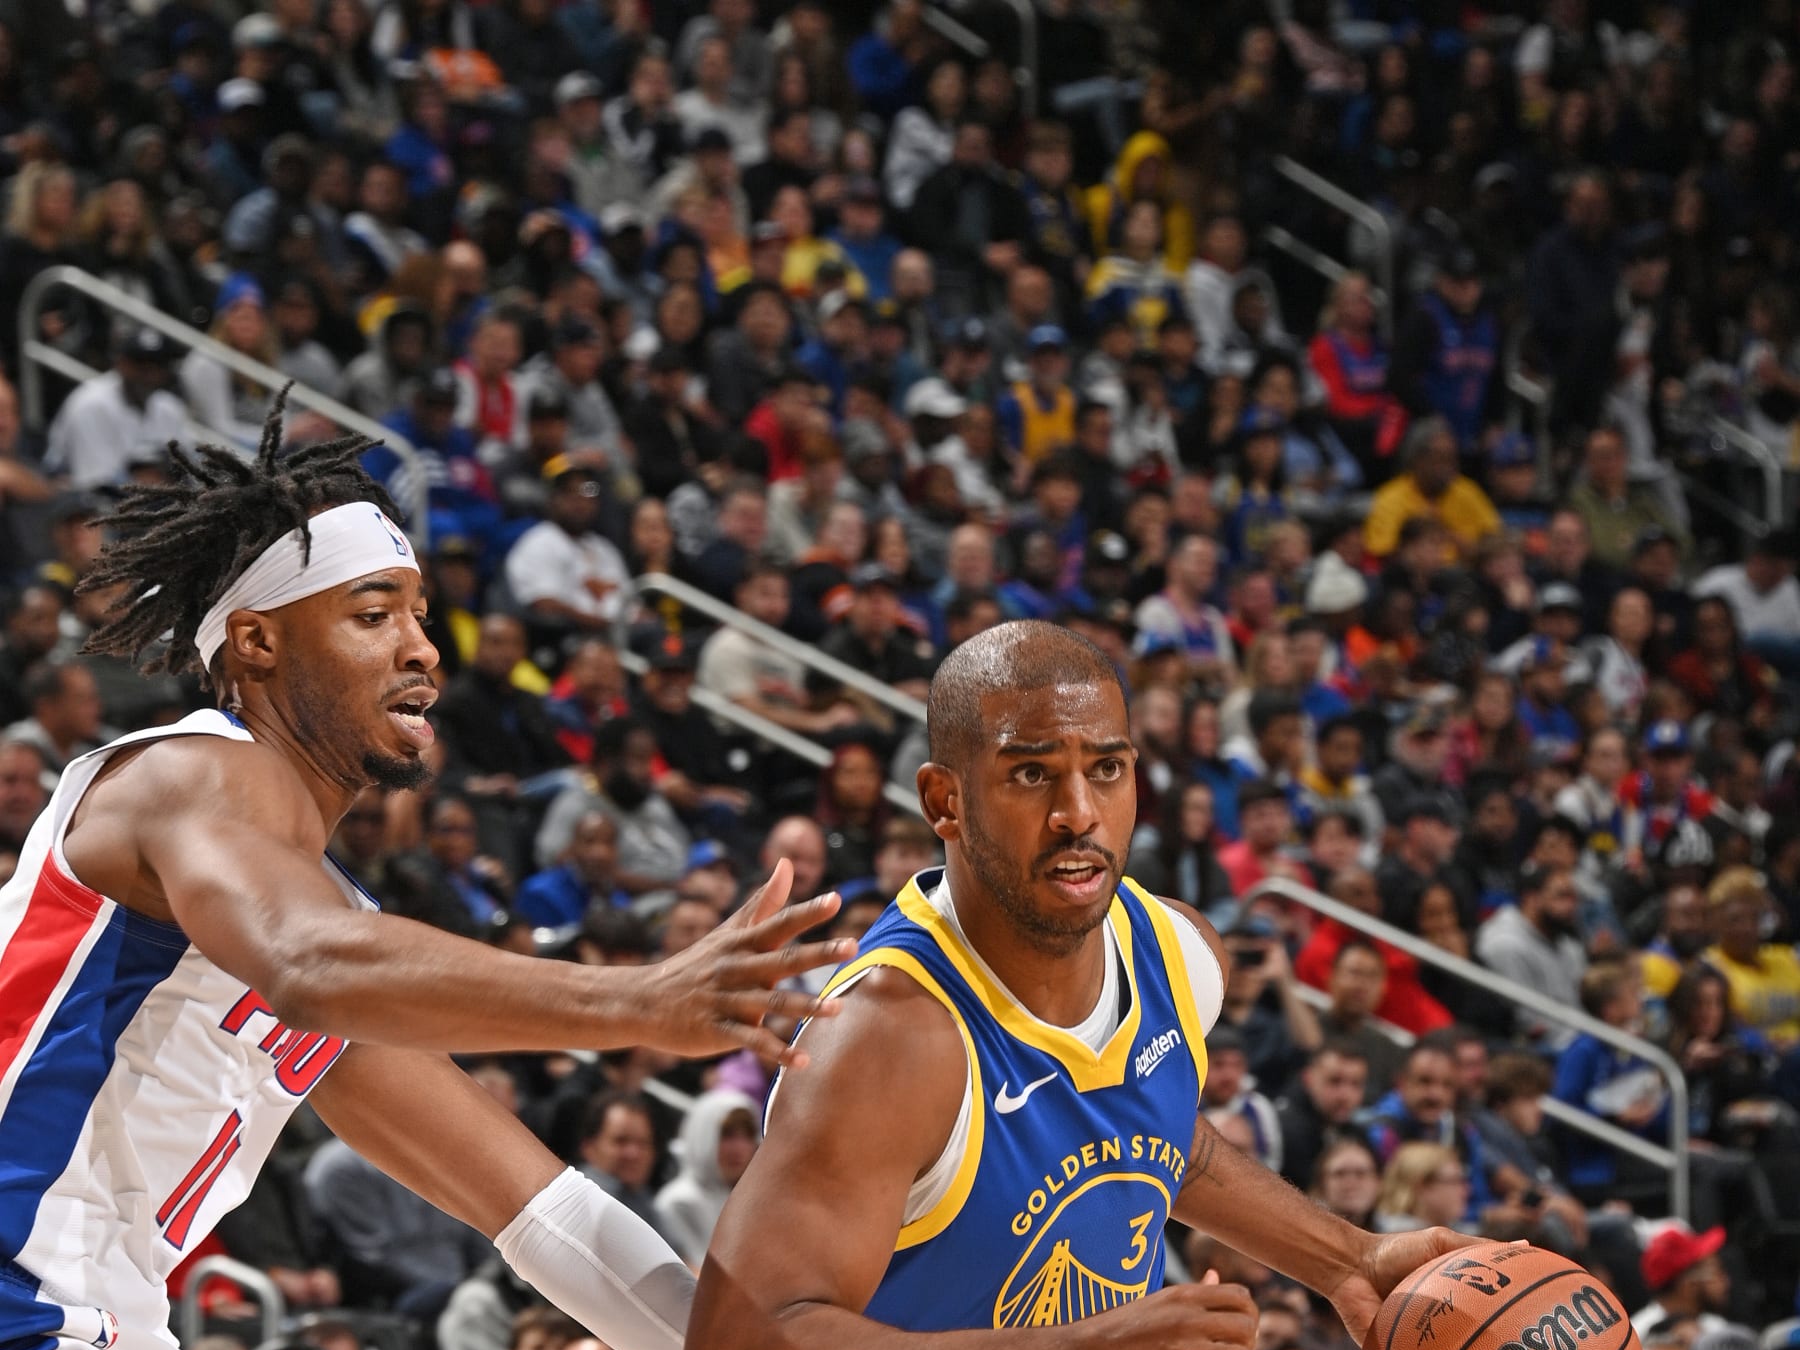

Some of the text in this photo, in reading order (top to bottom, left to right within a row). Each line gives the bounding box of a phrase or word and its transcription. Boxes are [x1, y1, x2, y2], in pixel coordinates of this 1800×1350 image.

[1135, 1029, 1181, 1078] Rakuten
[155, 1107, 243, 1252] 11
[1011, 1134, 1186, 1236] GOLDEN STATE
[1120, 1210, 1154, 1271] 3
